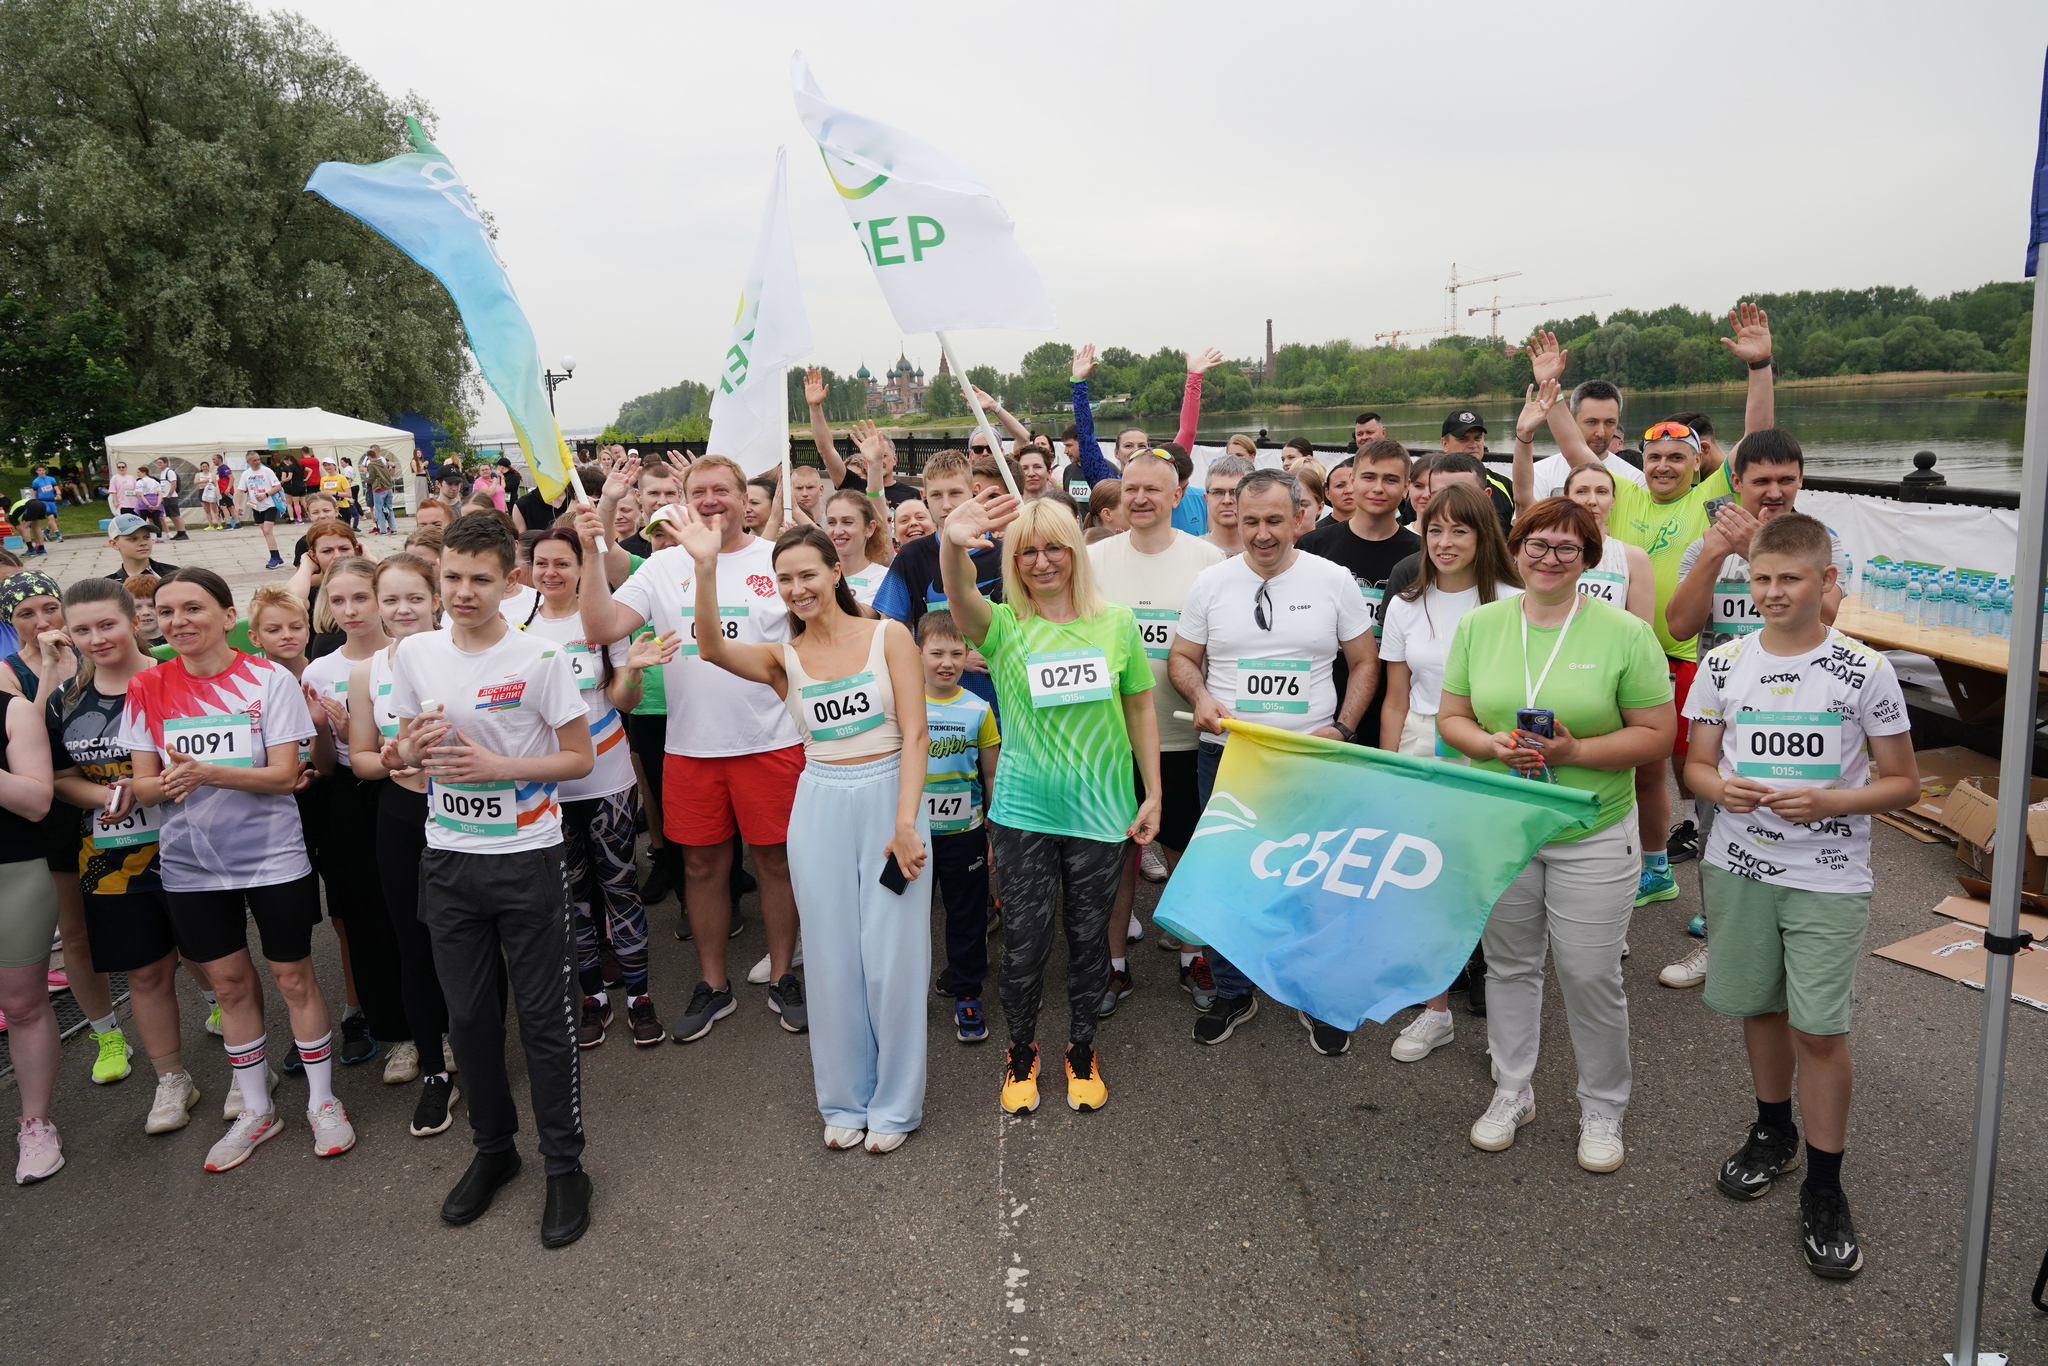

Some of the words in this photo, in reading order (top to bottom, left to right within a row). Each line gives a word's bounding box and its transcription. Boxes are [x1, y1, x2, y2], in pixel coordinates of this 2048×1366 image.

[853, 215, 946, 267] ЕР
[1071, 487, 1088, 496] 0037
[1040, 663, 1098, 689] 0275
[1760, 673, 1801, 684] EXTRA
[481, 683, 524, 696] ДОСТИГАЯ
[1247, 674, 1300, 696] 0076
[1769, 686, 1794, 695] FUN
[492, 690, 521, 702] ЦЕЛИ!
[1875, 699, 1890, 709] NO
[813, 692, 870, 723] 0043
[176, 731, 234, 755] 0091
[1751, 731, 1824, 758] 0080
[442, 792, 502, 818] 0095
[1746, 825, 1785, 841] EXTRA
[1727, 842, 1787, 876] ENJOY
[1814, 853, 1850, 864] RULES
[1830, 863, 1845, 871] NO
